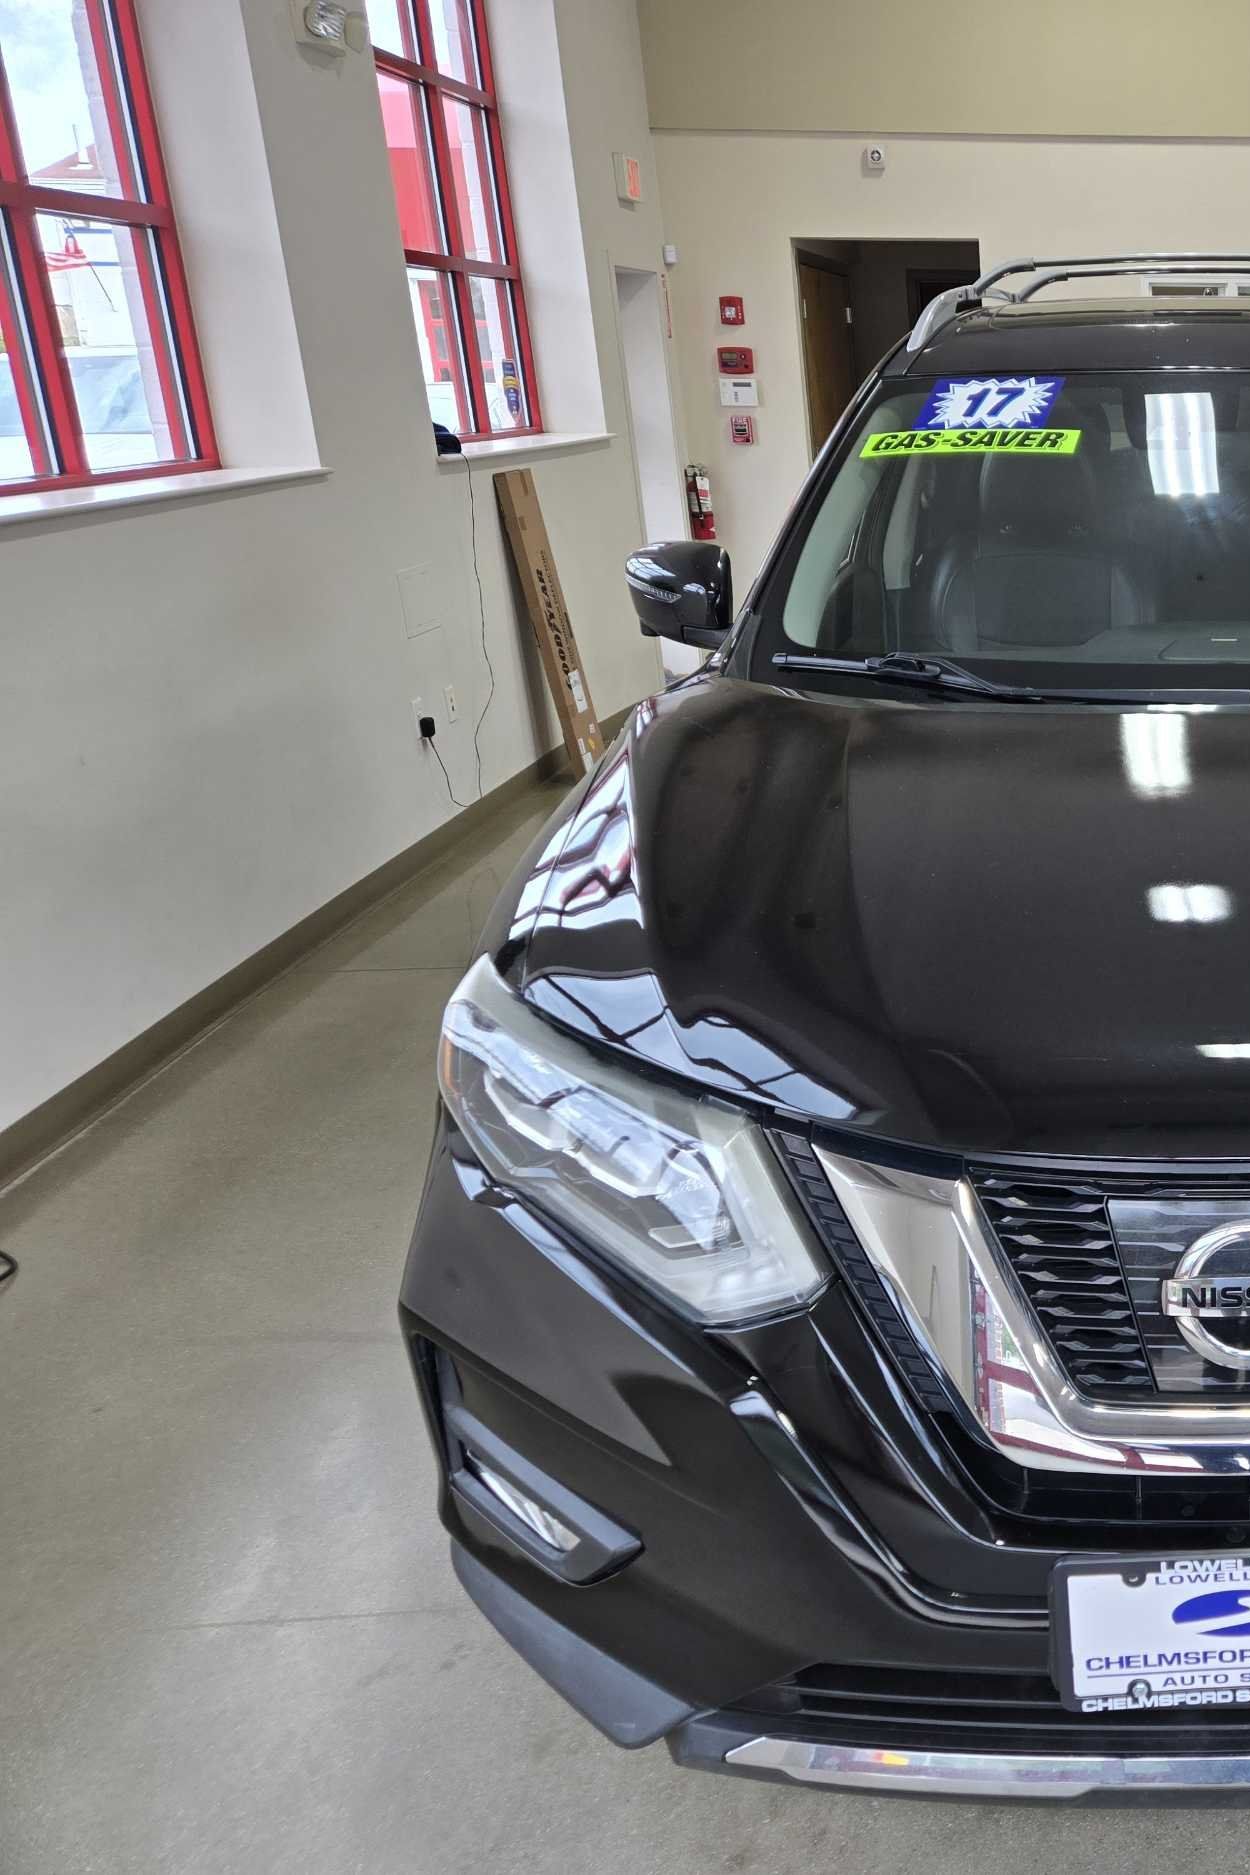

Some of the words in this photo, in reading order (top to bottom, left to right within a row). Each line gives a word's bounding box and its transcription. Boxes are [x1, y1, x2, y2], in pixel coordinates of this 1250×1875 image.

[963, 387, 1026, 418] 17
[871, 430, 1067, 452] GAS-SAVER
[1162, 1674, 1230, 1688] AUTO
[1081, 1690, 1235, 1713] CHELMSFORD
